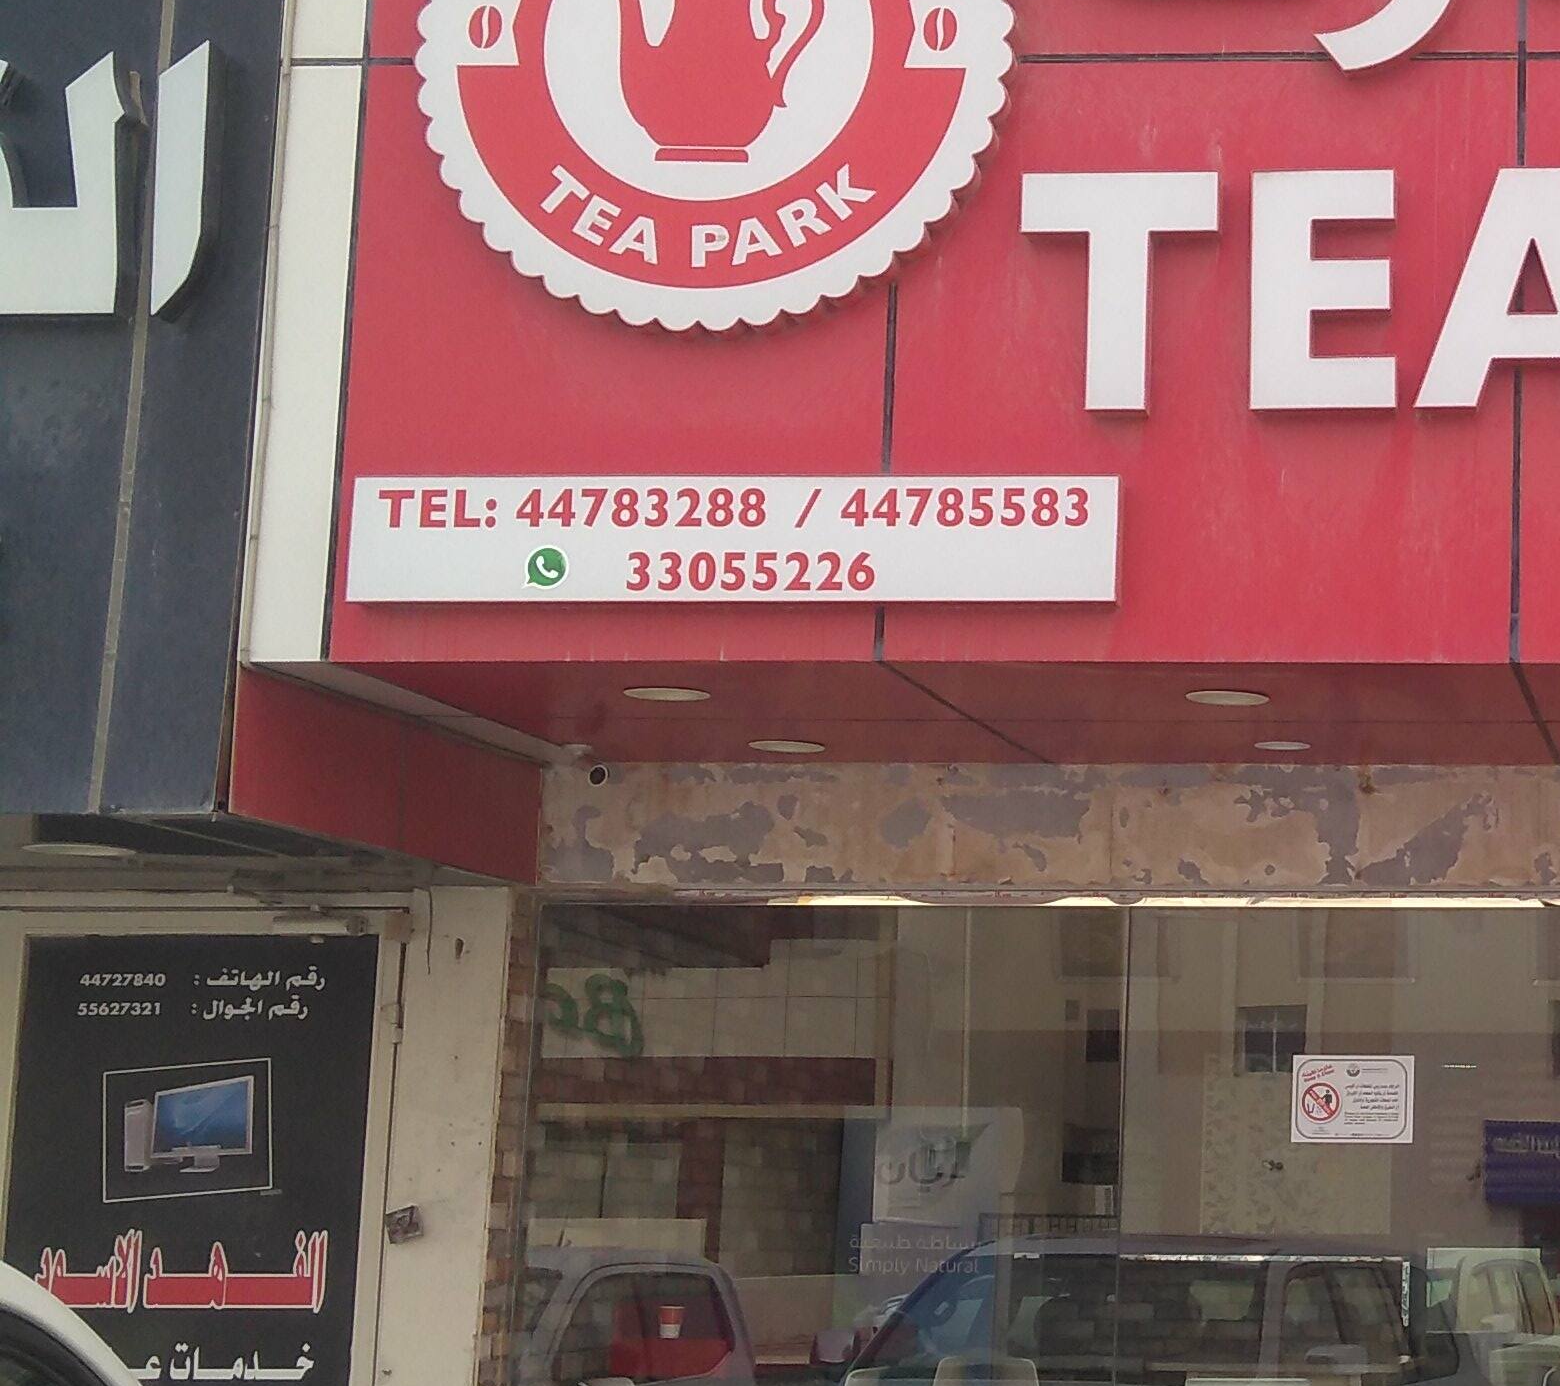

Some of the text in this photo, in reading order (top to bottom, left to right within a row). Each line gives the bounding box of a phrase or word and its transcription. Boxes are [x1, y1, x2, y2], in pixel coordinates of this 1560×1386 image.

[540, 163, 877, 269] TEA PARK
[378, 487, 1090, 529] TEL: 44783288 / 44785583
[625, 551, 876, 592] 33055226
[79, 972, 167, 988] 44727840
[207, 967, 281, 992] الهاتف
[286, 965, 326, 991] رقم
[77, 1001, 162, 1016] 55627321
[203, 996, 264, 1021] الجوال
[268, 994, 309, 1021] رقم
[143, 1229, 328, 1313] الفهد
[848, 1256, 979, 1278] Simply Natural
[169, 1342, 316, 1381] خدمات
